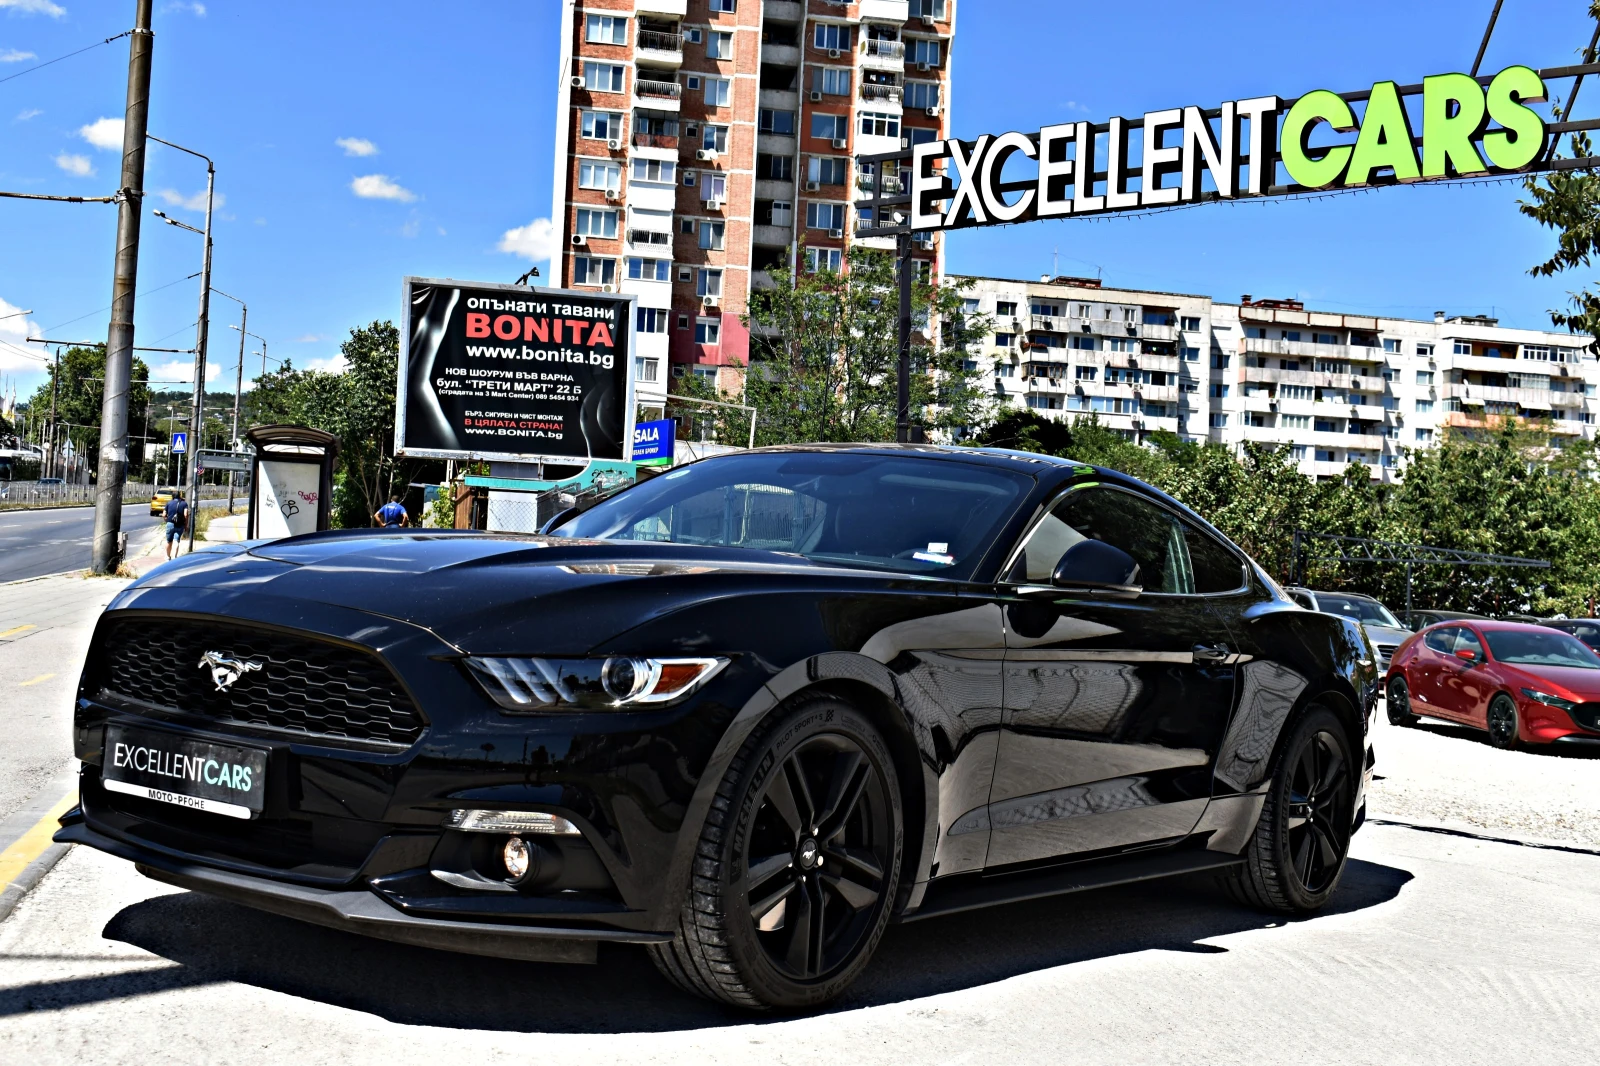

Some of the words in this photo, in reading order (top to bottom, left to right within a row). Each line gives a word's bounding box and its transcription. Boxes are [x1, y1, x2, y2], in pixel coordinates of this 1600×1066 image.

[467, 297, 547, 315] опънати
[552, 303, 615, 320] тавани
[465, 312, 614, 347] BONITA
[466, 345, 615, 369] www.bonita.bg
[445, 367, 467, 376] НОВ
[469, 369, 514, 379] ШОУРУМ
[515, 371, 538, 380] ВЪВ
[540, 373, 574, 382] ВАРНА
[436, 378, 462, 389] бул.
[556, 384, 570, 393] 22
[573, 385, 582, 394] Б
[438, 389, 473, 397] (сградата
[508, 392, 534, 400] Center)
[474, 419, 517, 428] ЦЯЛАТА
[519, 421, 563, 430] СТРАНА!
[484, 411, 513, 419] СИГУРЕН
[536, 413, 564, 421] МОНТАЖ
[464, 428, 563, 440] www.BONITA.bg
[776, 729, 793, 750] PILOT
[794, 714, 816, 733] SPORT
[148, 789, 205, 809] MOTO-PFOHE
[733, 756, 774, 853] MICHELIN
